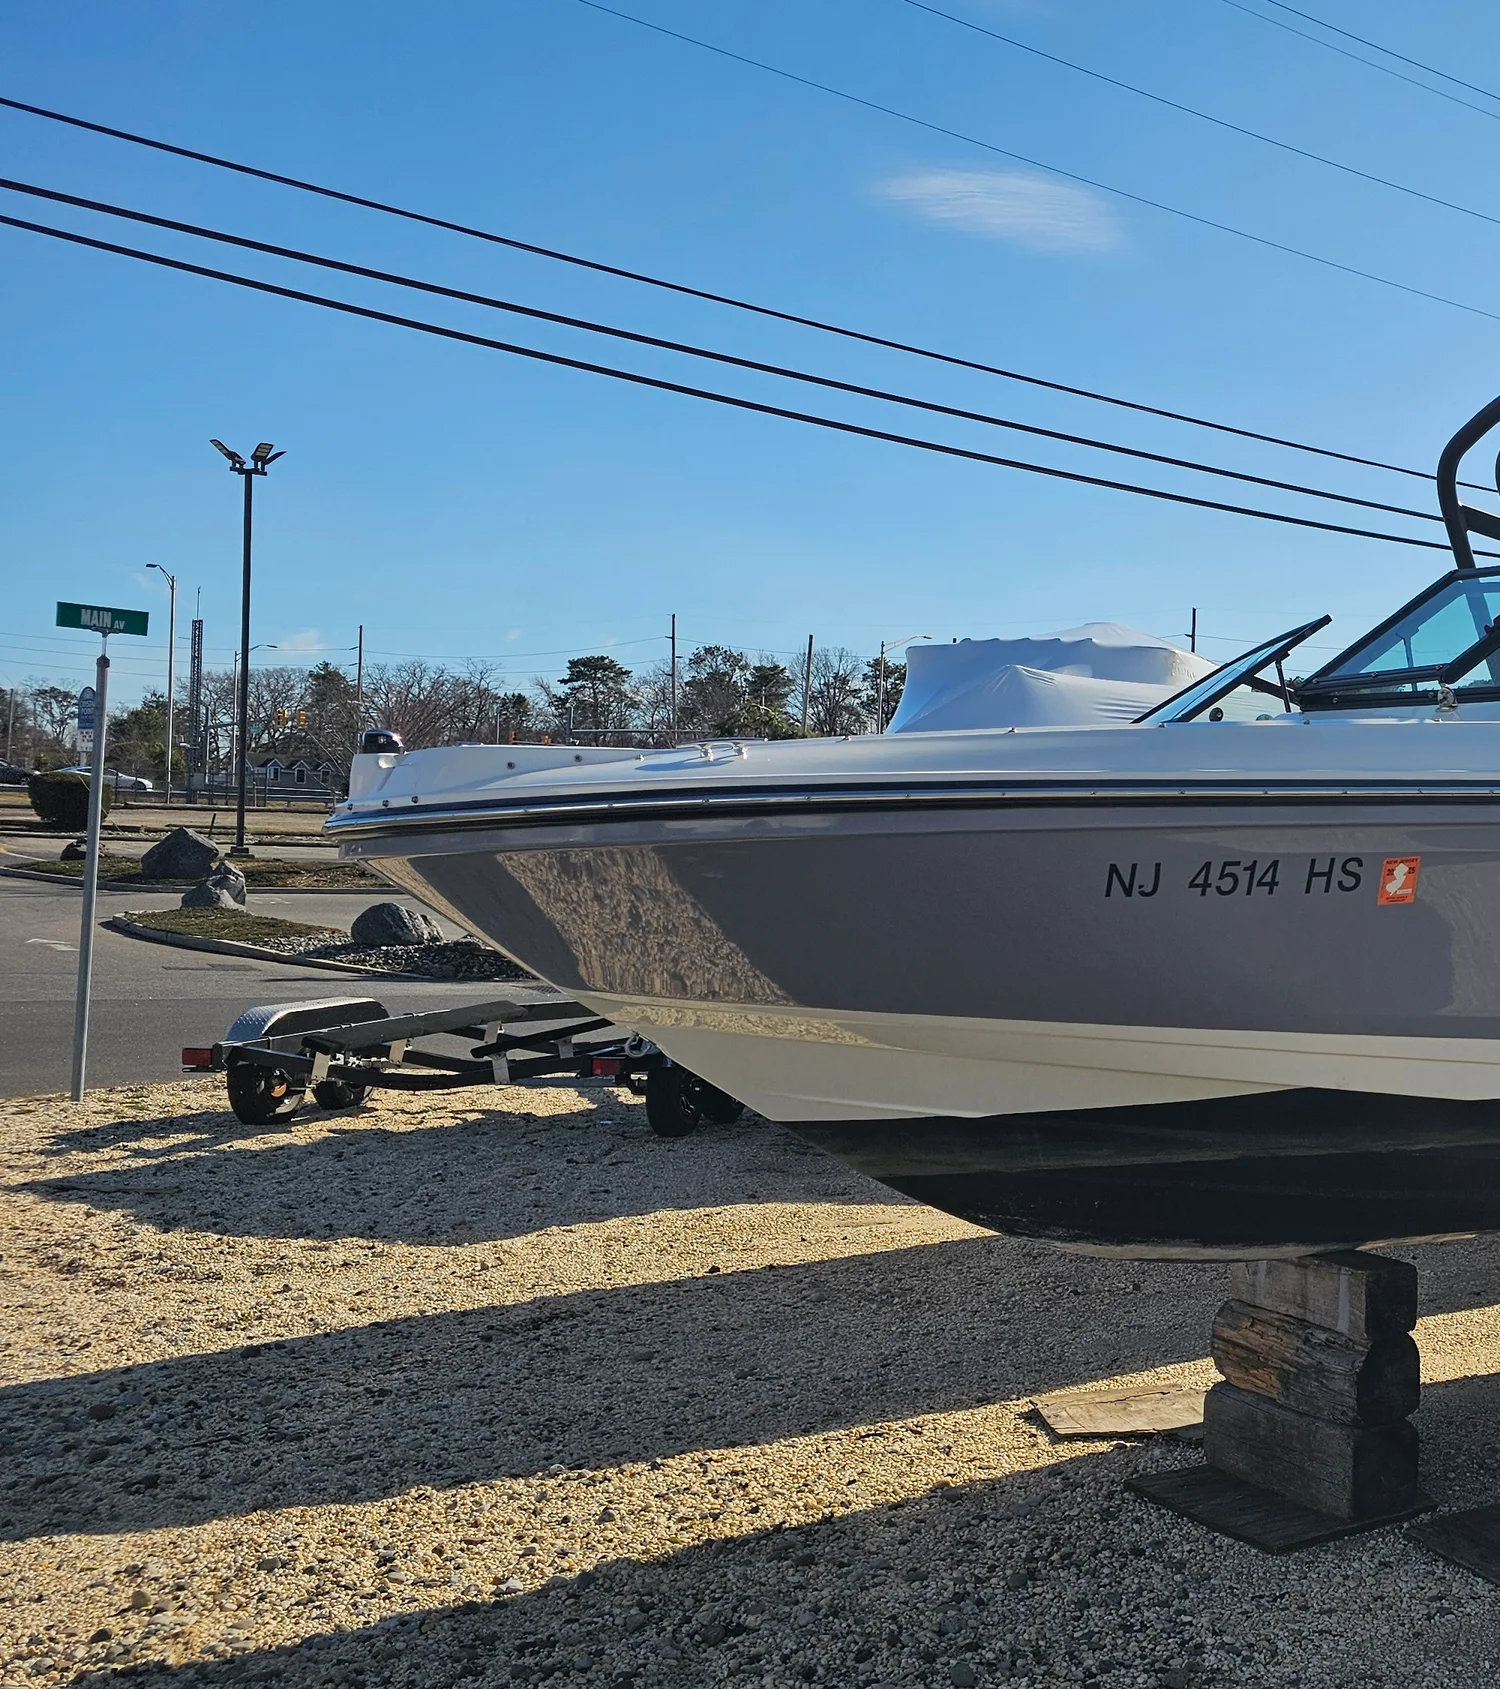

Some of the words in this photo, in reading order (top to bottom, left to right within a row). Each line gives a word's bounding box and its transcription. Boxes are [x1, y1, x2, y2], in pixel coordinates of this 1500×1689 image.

[80, 608, 112, 628] MAIN
[113, 620, 125, 630] AV
[1104, 862, 1162, 897] NJ
[1188, 859, 1280, 897] 4514
[1304, 856, 1364, 894] HS
